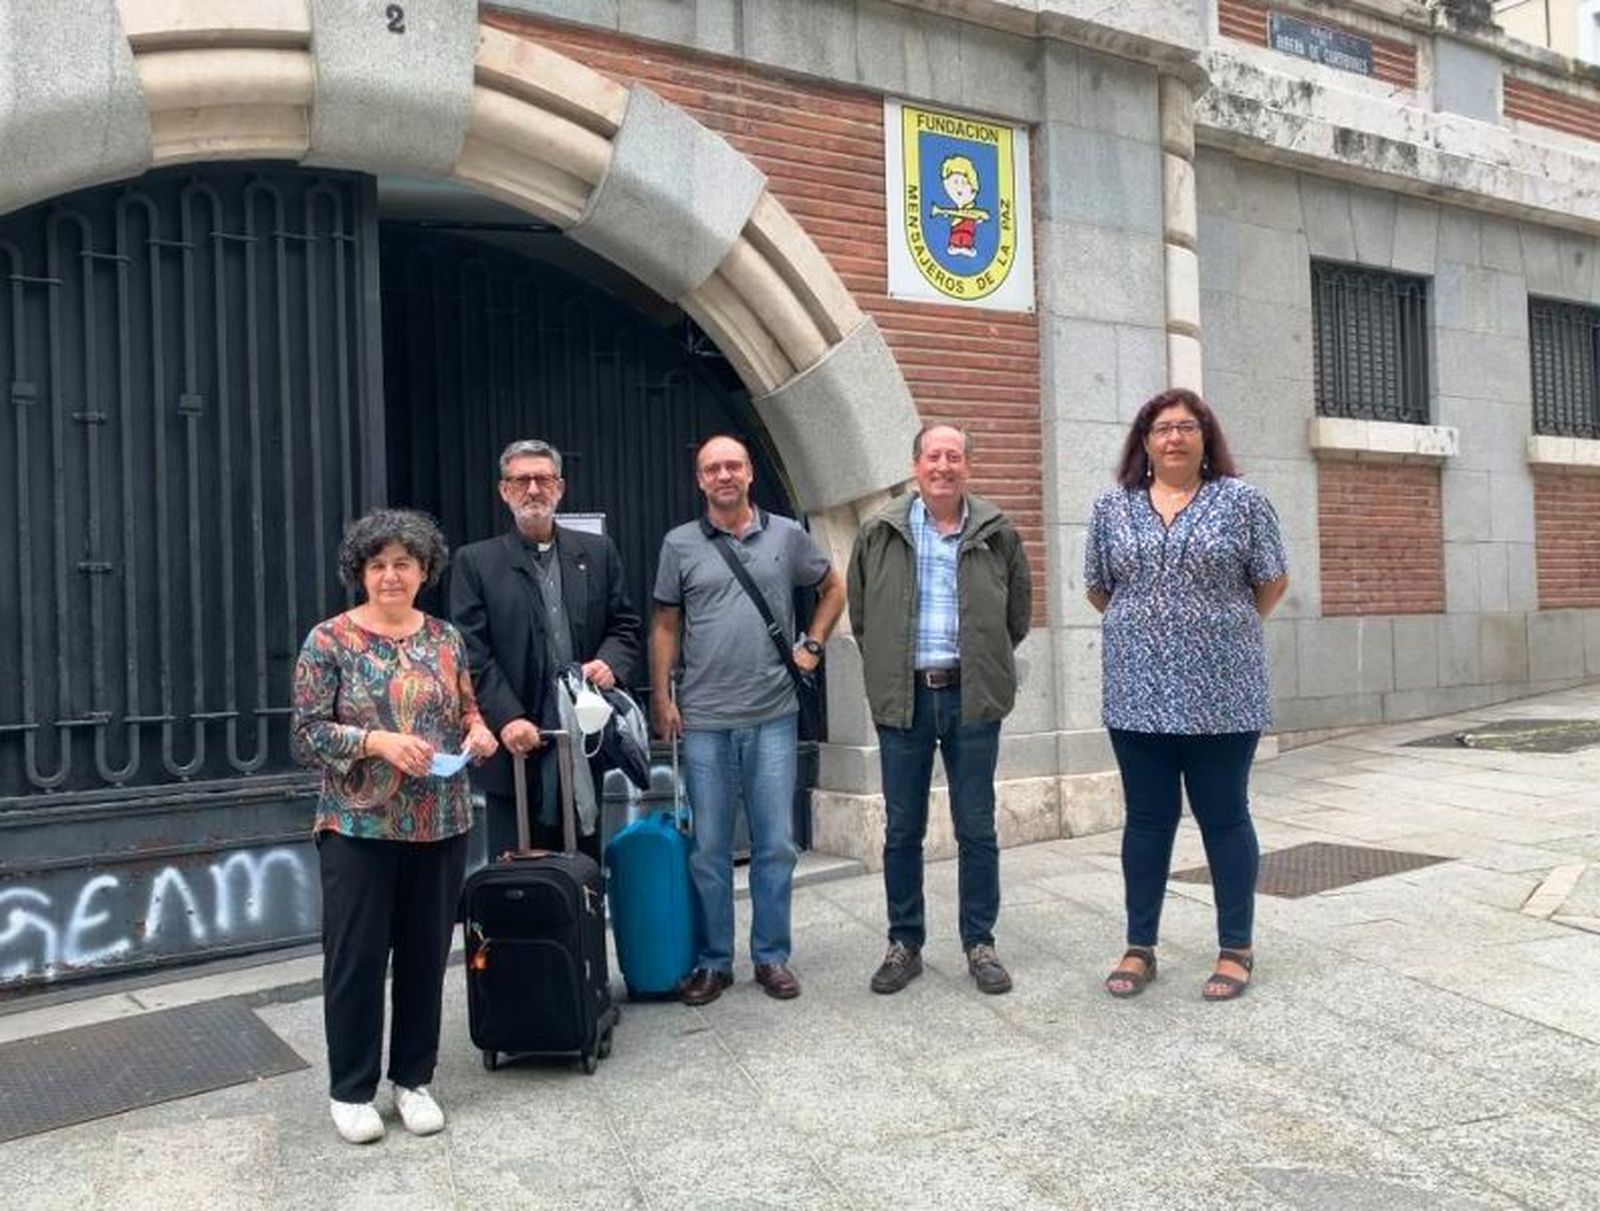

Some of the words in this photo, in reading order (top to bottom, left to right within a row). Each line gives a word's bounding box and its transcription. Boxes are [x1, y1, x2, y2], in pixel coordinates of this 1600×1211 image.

[386, 3, 405, 34] 2
[1000, 199, 1011, 231] PAZ
[907, 184, 965, 294] MENSAJEROS
[1000, 244, 1011, 267] LA
[976, 275, 995, 291] DE
